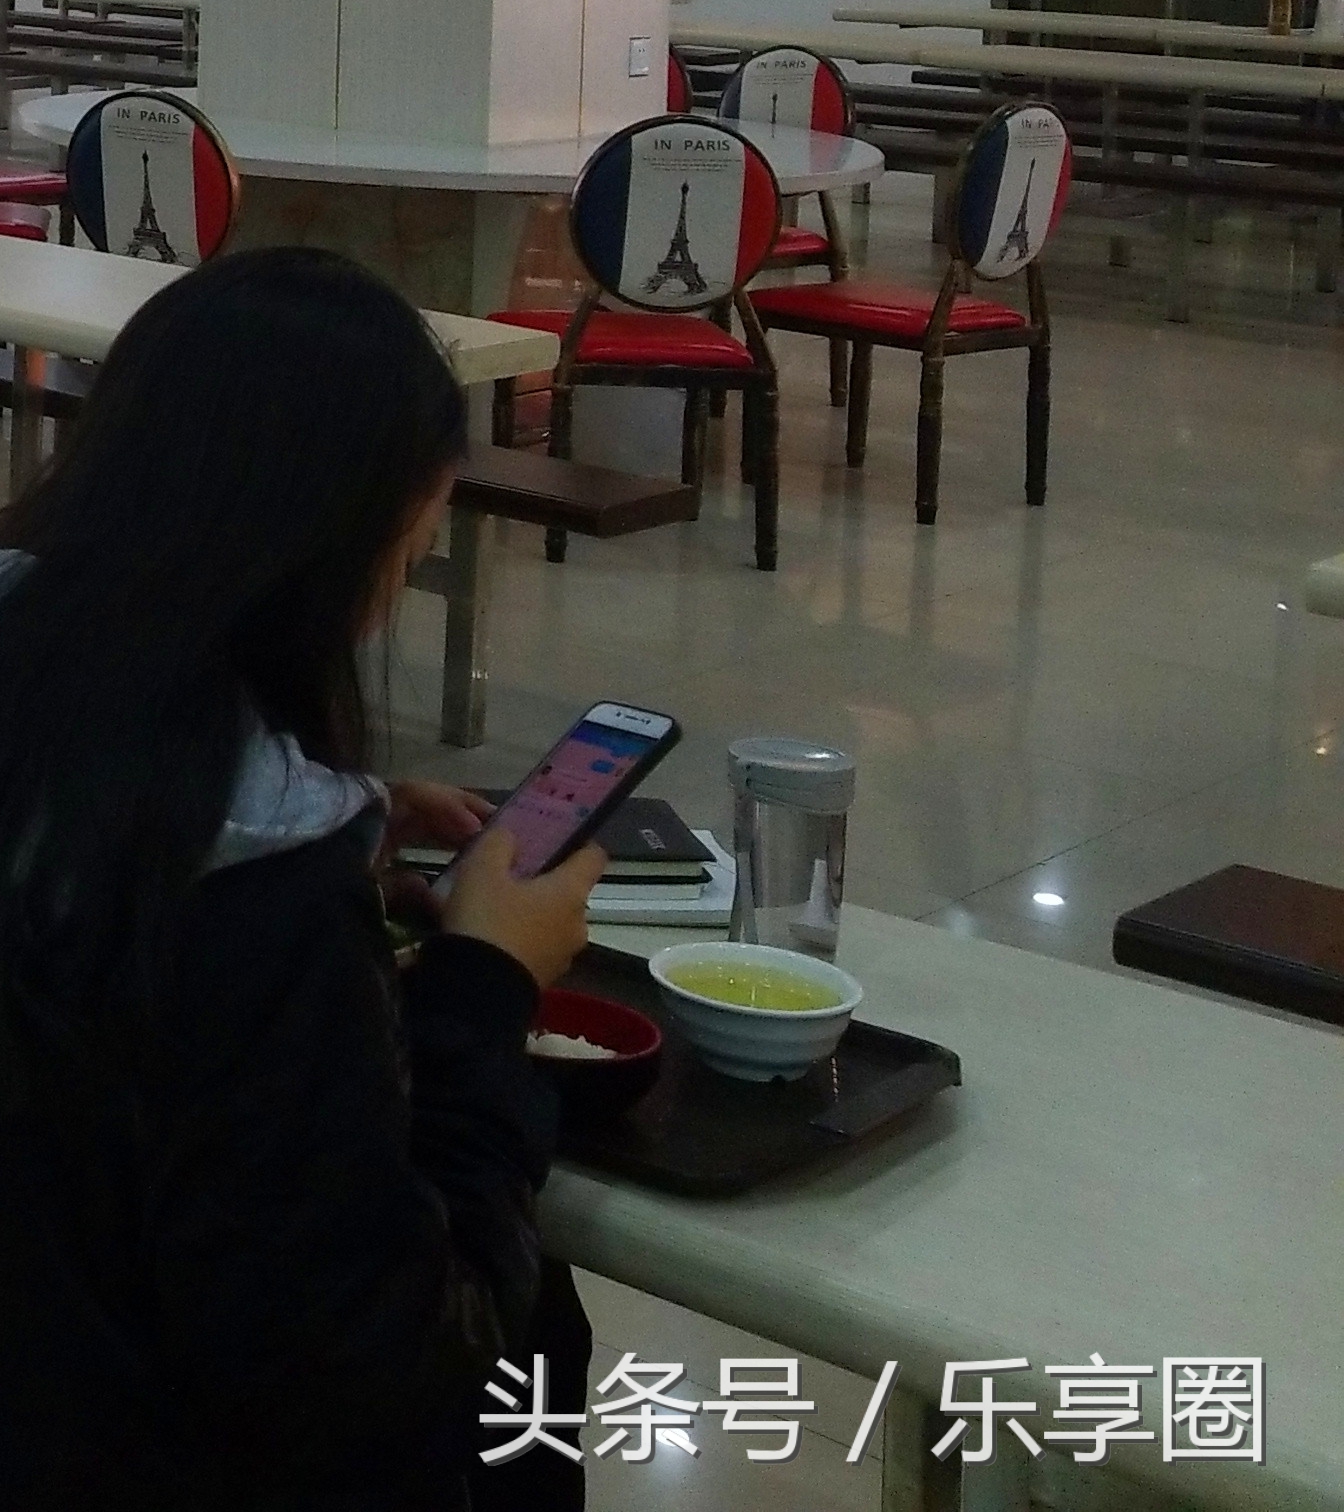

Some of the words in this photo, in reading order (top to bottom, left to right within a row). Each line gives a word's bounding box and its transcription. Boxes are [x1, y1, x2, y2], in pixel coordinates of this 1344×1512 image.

[774, 60, 807, 69] PARIS
[117, 107, 131, 119] IN
[140, 110, 181, 124] PARIS
[654, 139, 672, 150] IN
[684, 139, 731, 151] PARIS
